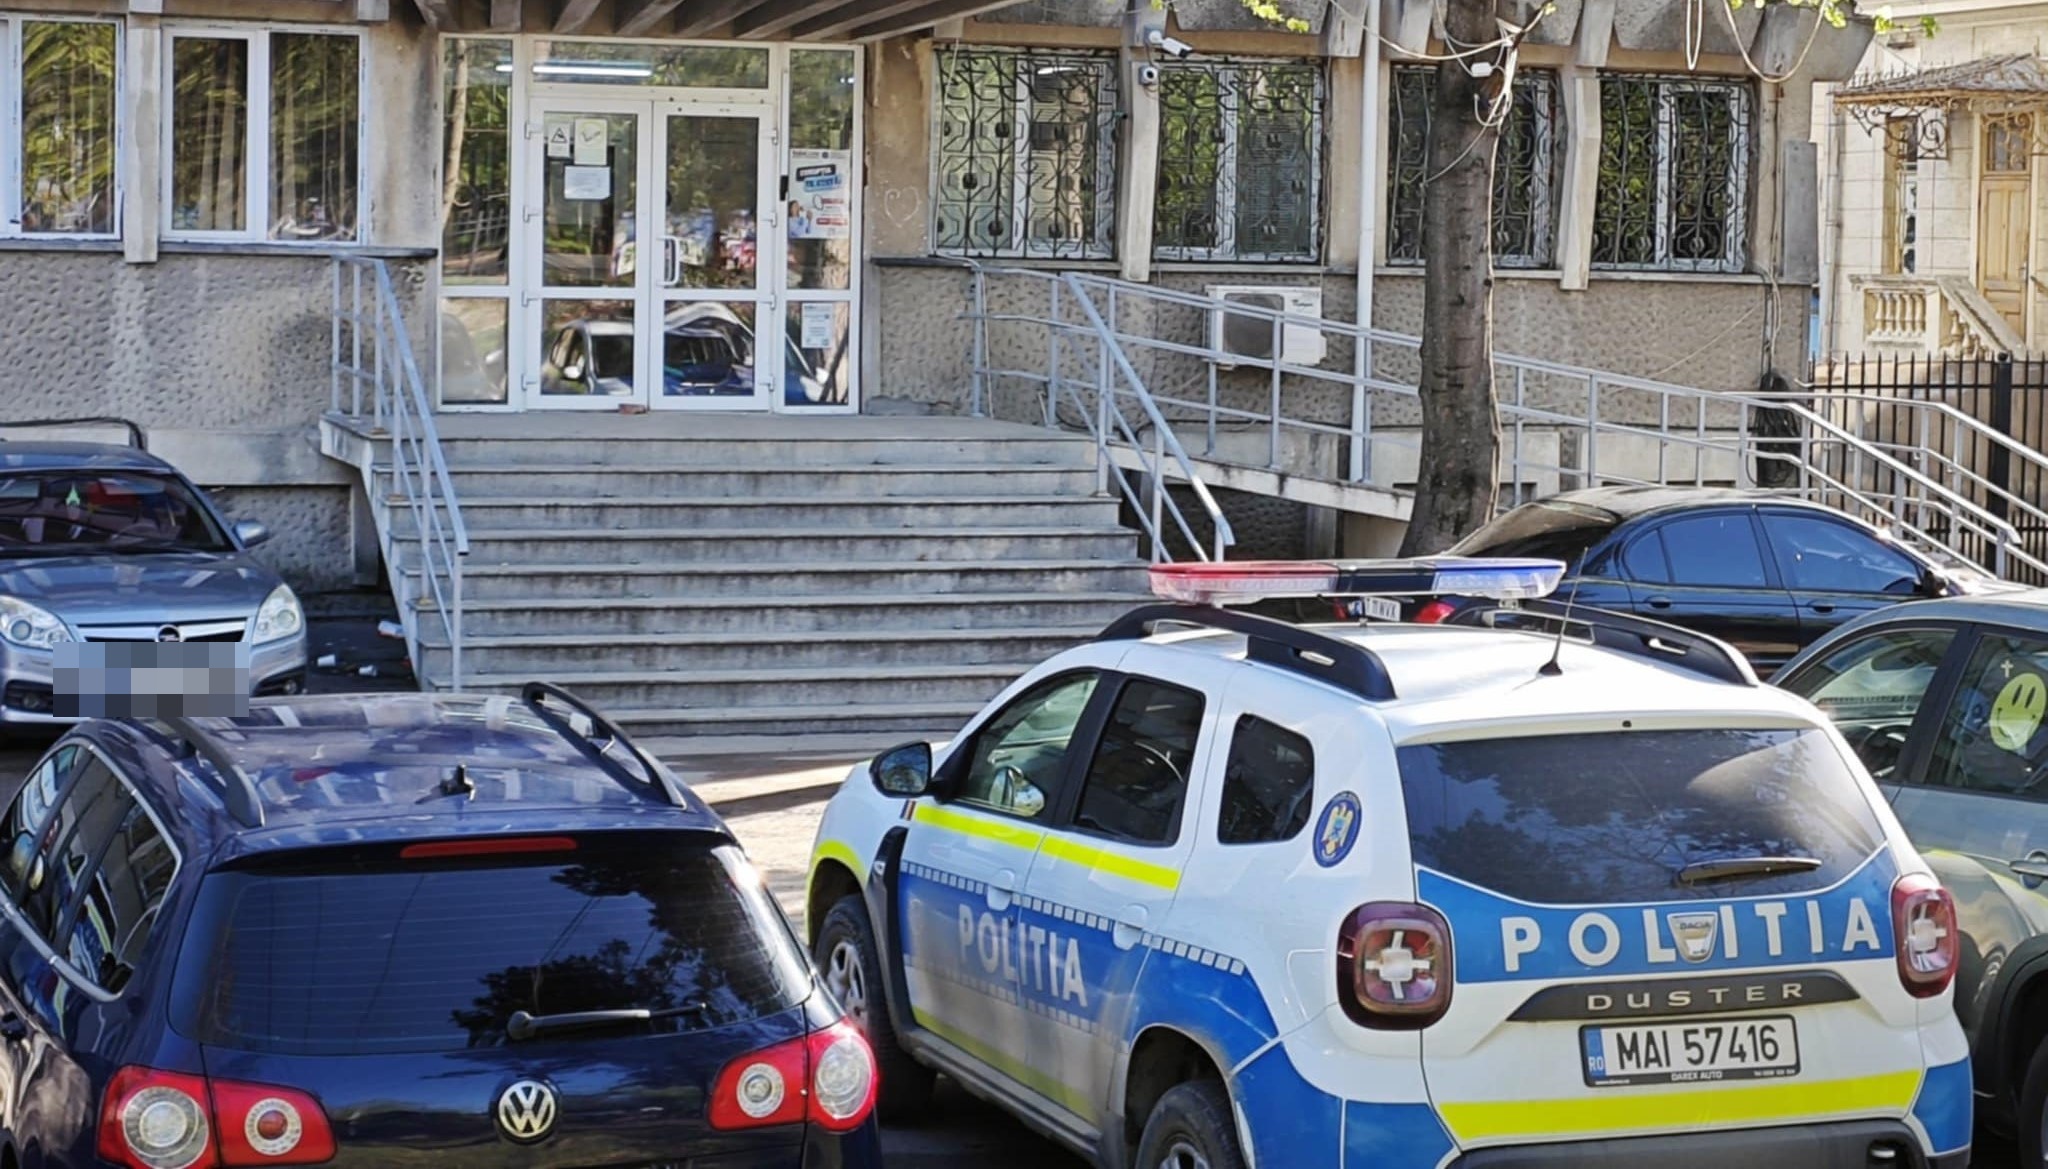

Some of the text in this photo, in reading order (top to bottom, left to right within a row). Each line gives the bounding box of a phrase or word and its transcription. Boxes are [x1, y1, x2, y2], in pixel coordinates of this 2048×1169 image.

[1501, 897, 1881, 972] POLITIA
[958, 902, 1088, 1007] POLITIA
[1588, 982, 1803, 1011] DUSTER
[1588, 1055, 1605, 1072] RO
[1616, 1024, 1779, 1070] MAI 57416
[1700, 1070, 1723, 1080] AUTO
